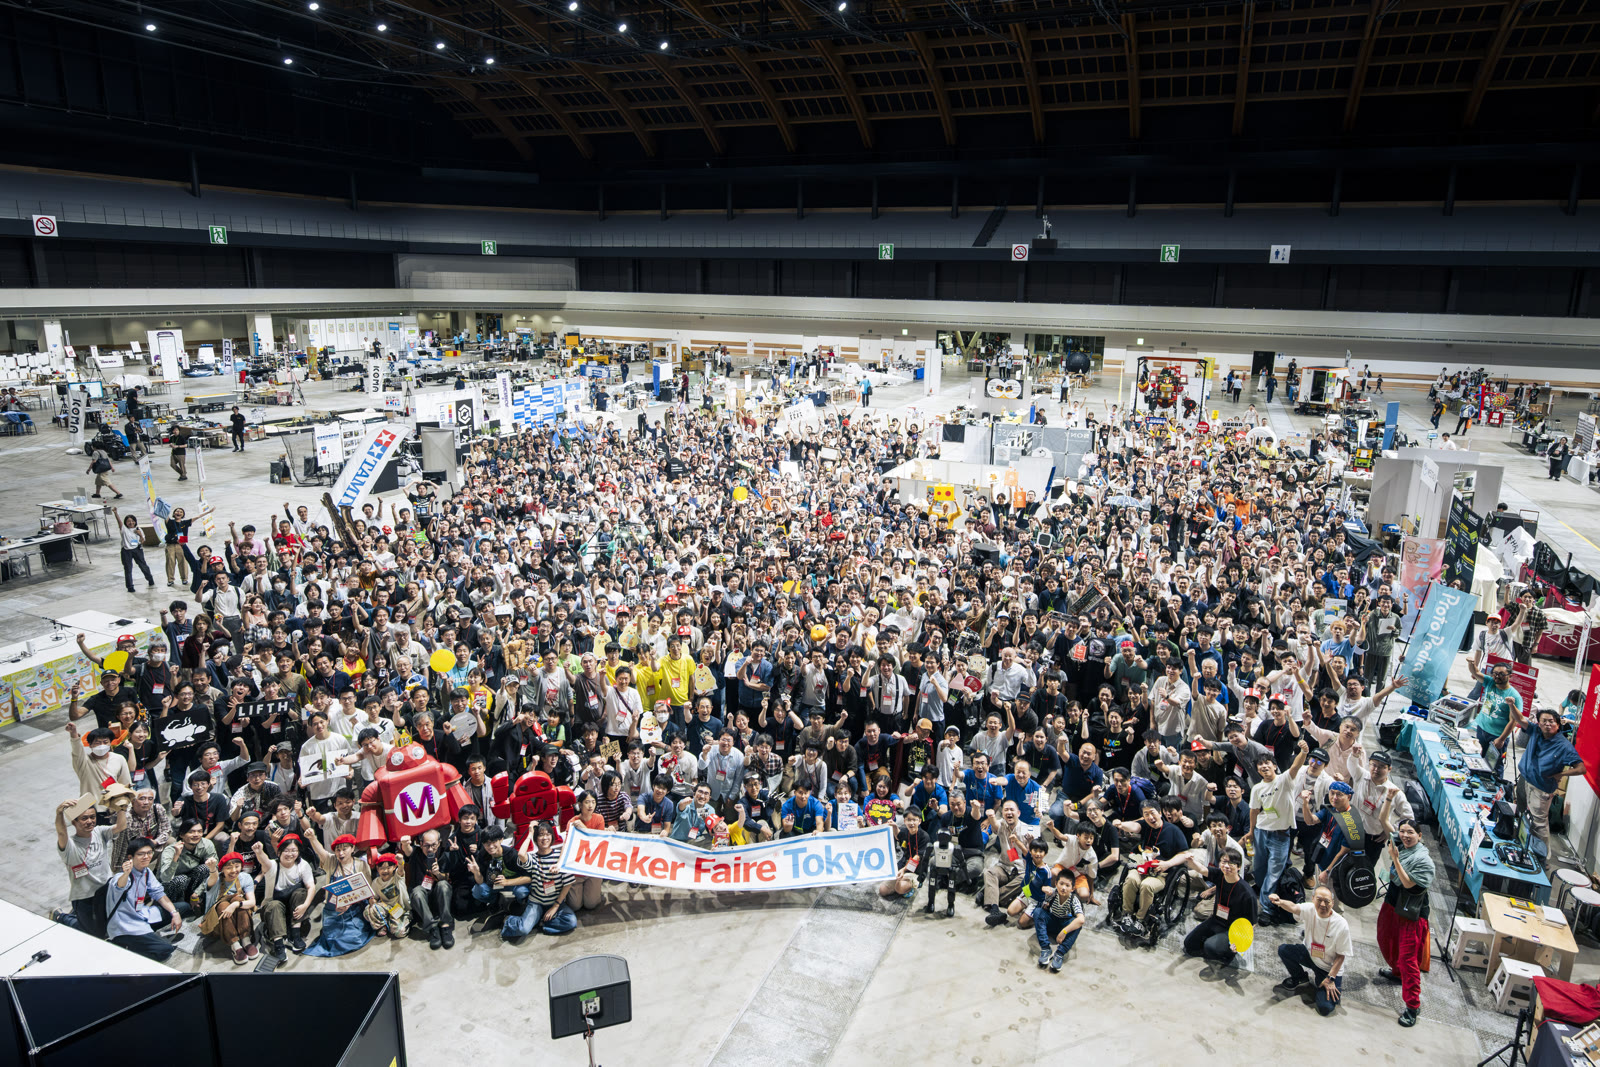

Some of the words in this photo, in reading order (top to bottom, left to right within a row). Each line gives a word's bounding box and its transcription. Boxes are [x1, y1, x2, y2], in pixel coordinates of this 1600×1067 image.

[238, 701, 288, 717] LIFTH
[401, 735, 411, 746] 15
[399, 785, 435, 823] M
[527, 800, 544, 815] M
[574, 840, 686, 881] Maker
[693, 856, 778, 884] Faire
[783, 844, 886, 881] Tokyo
